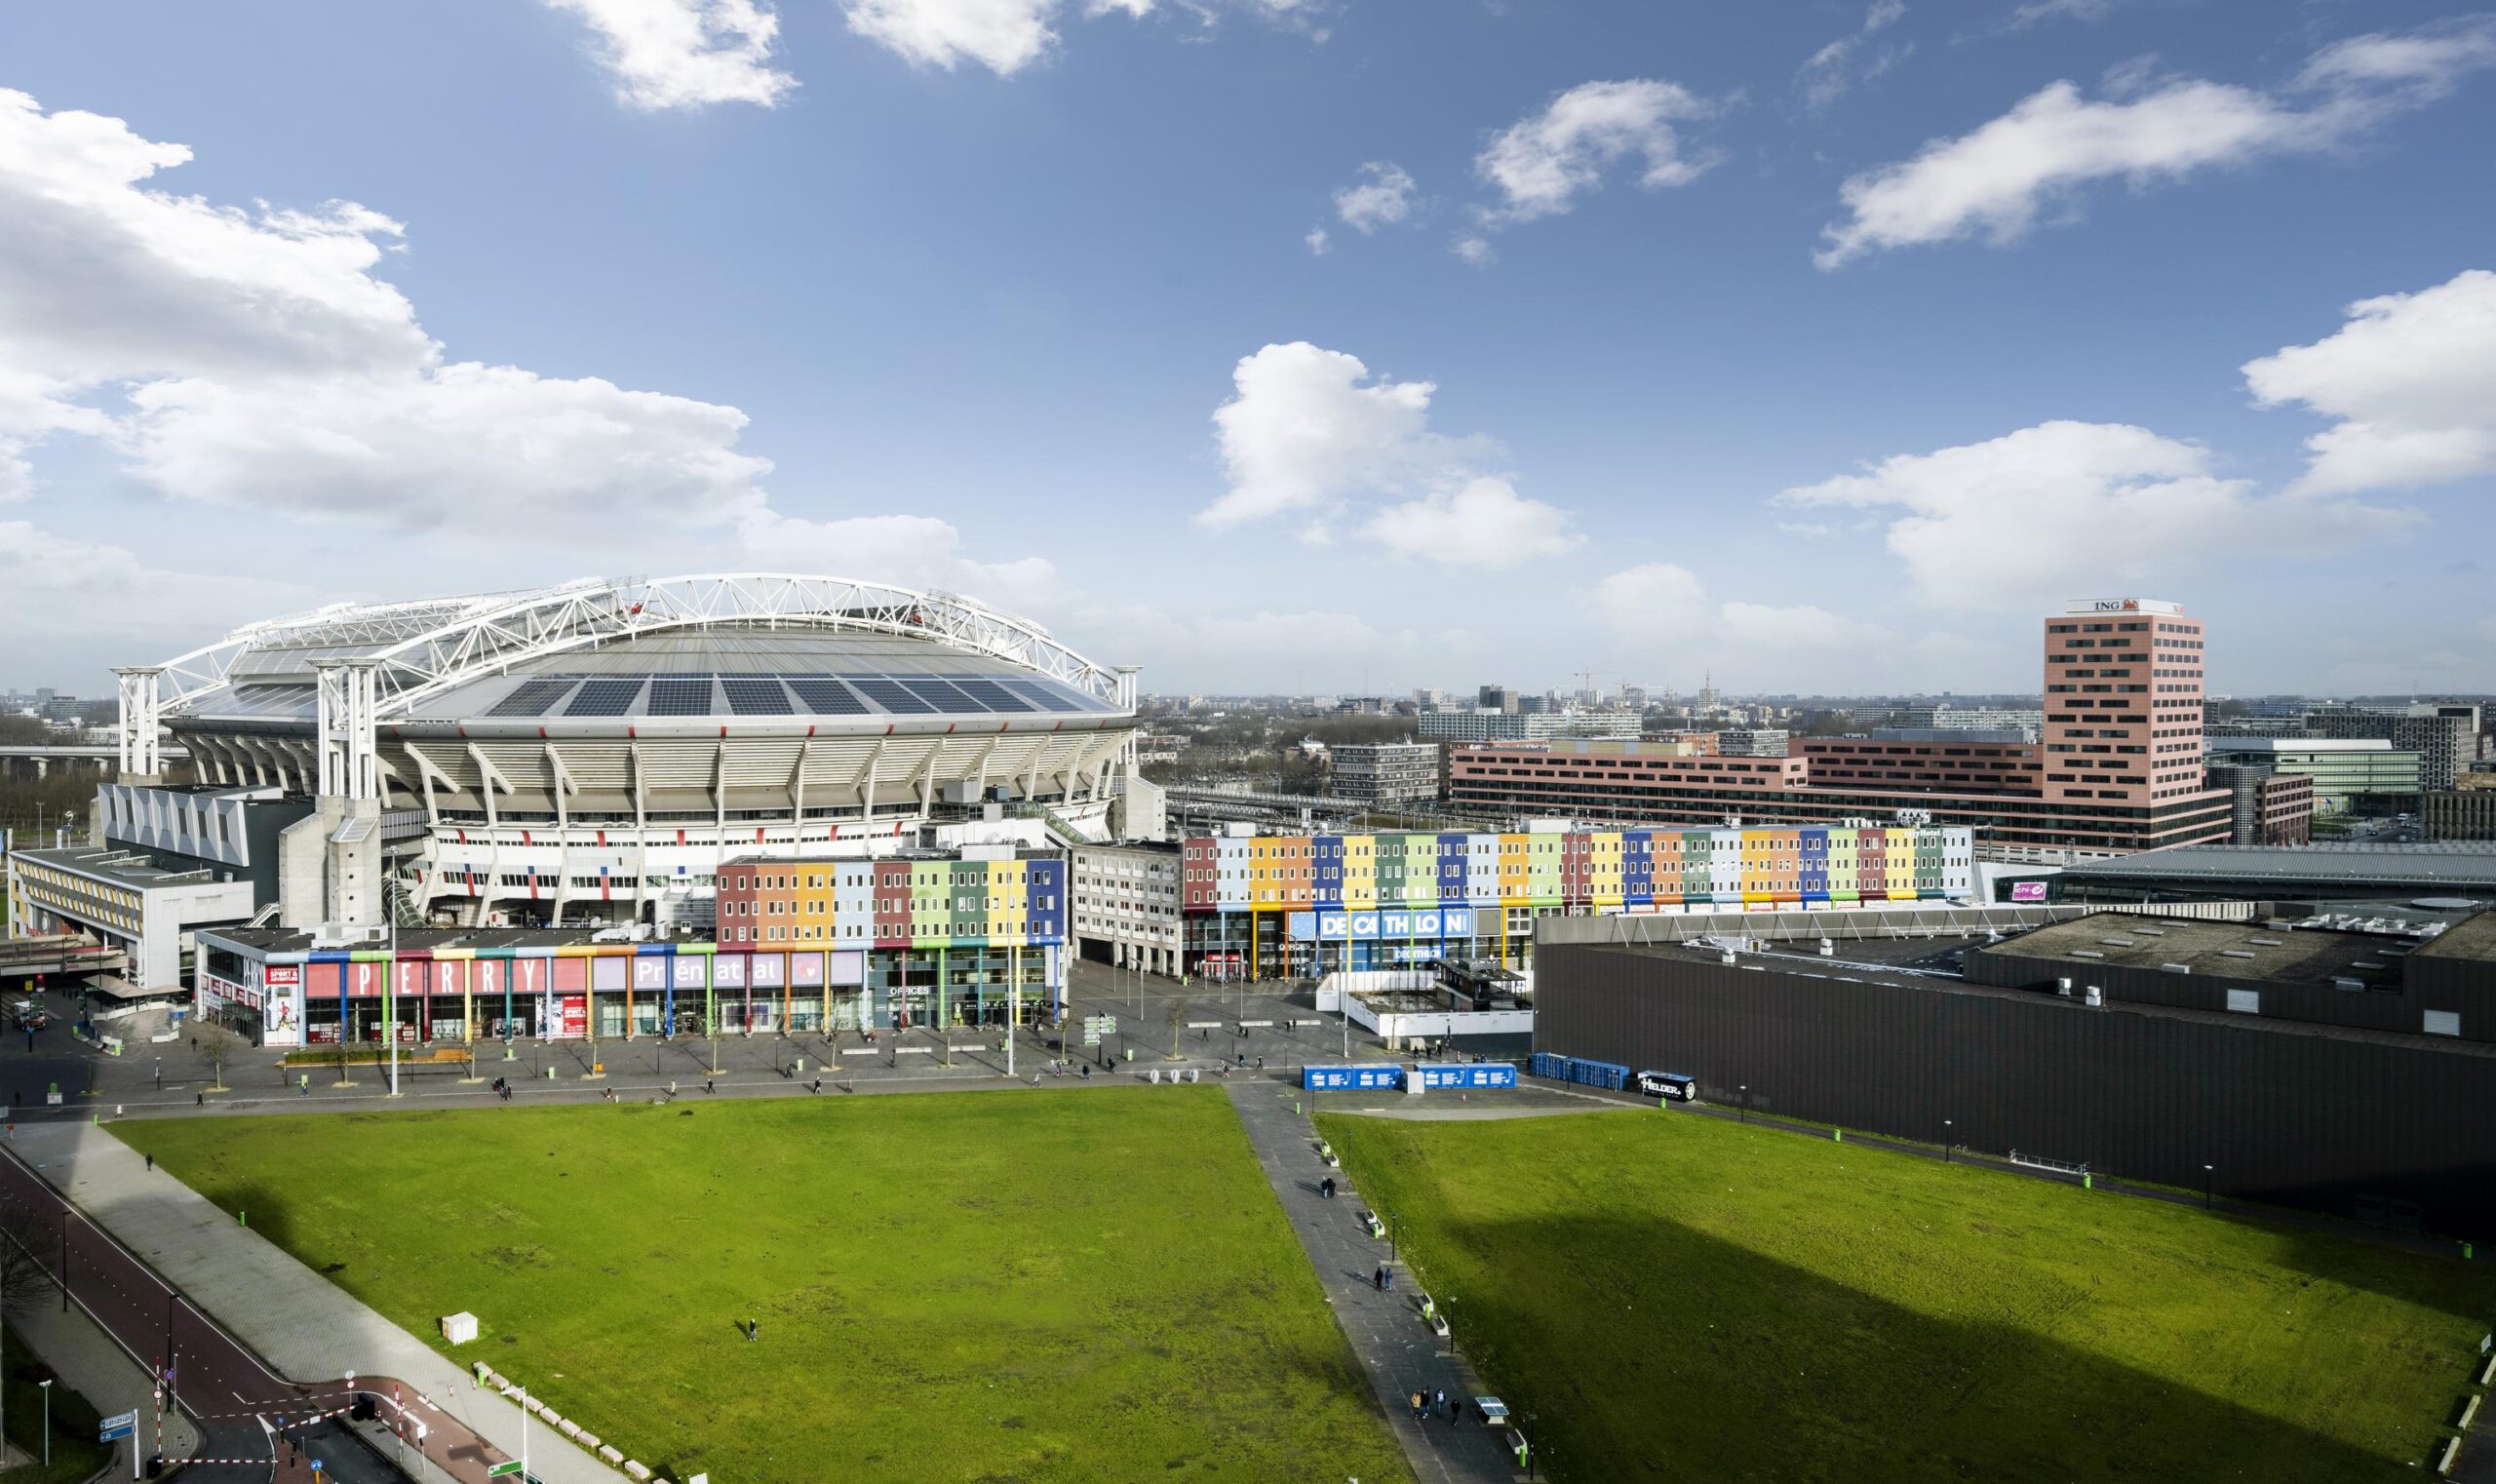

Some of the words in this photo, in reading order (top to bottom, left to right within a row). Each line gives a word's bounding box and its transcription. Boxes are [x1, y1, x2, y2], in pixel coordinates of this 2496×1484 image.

[2095, 602, 2120, 610] ING
[1322, 914, 1462, 935] DECATHLON
[359, 960, 535, 995] PERRY
[638, 960, 775, 982] Prénatal
